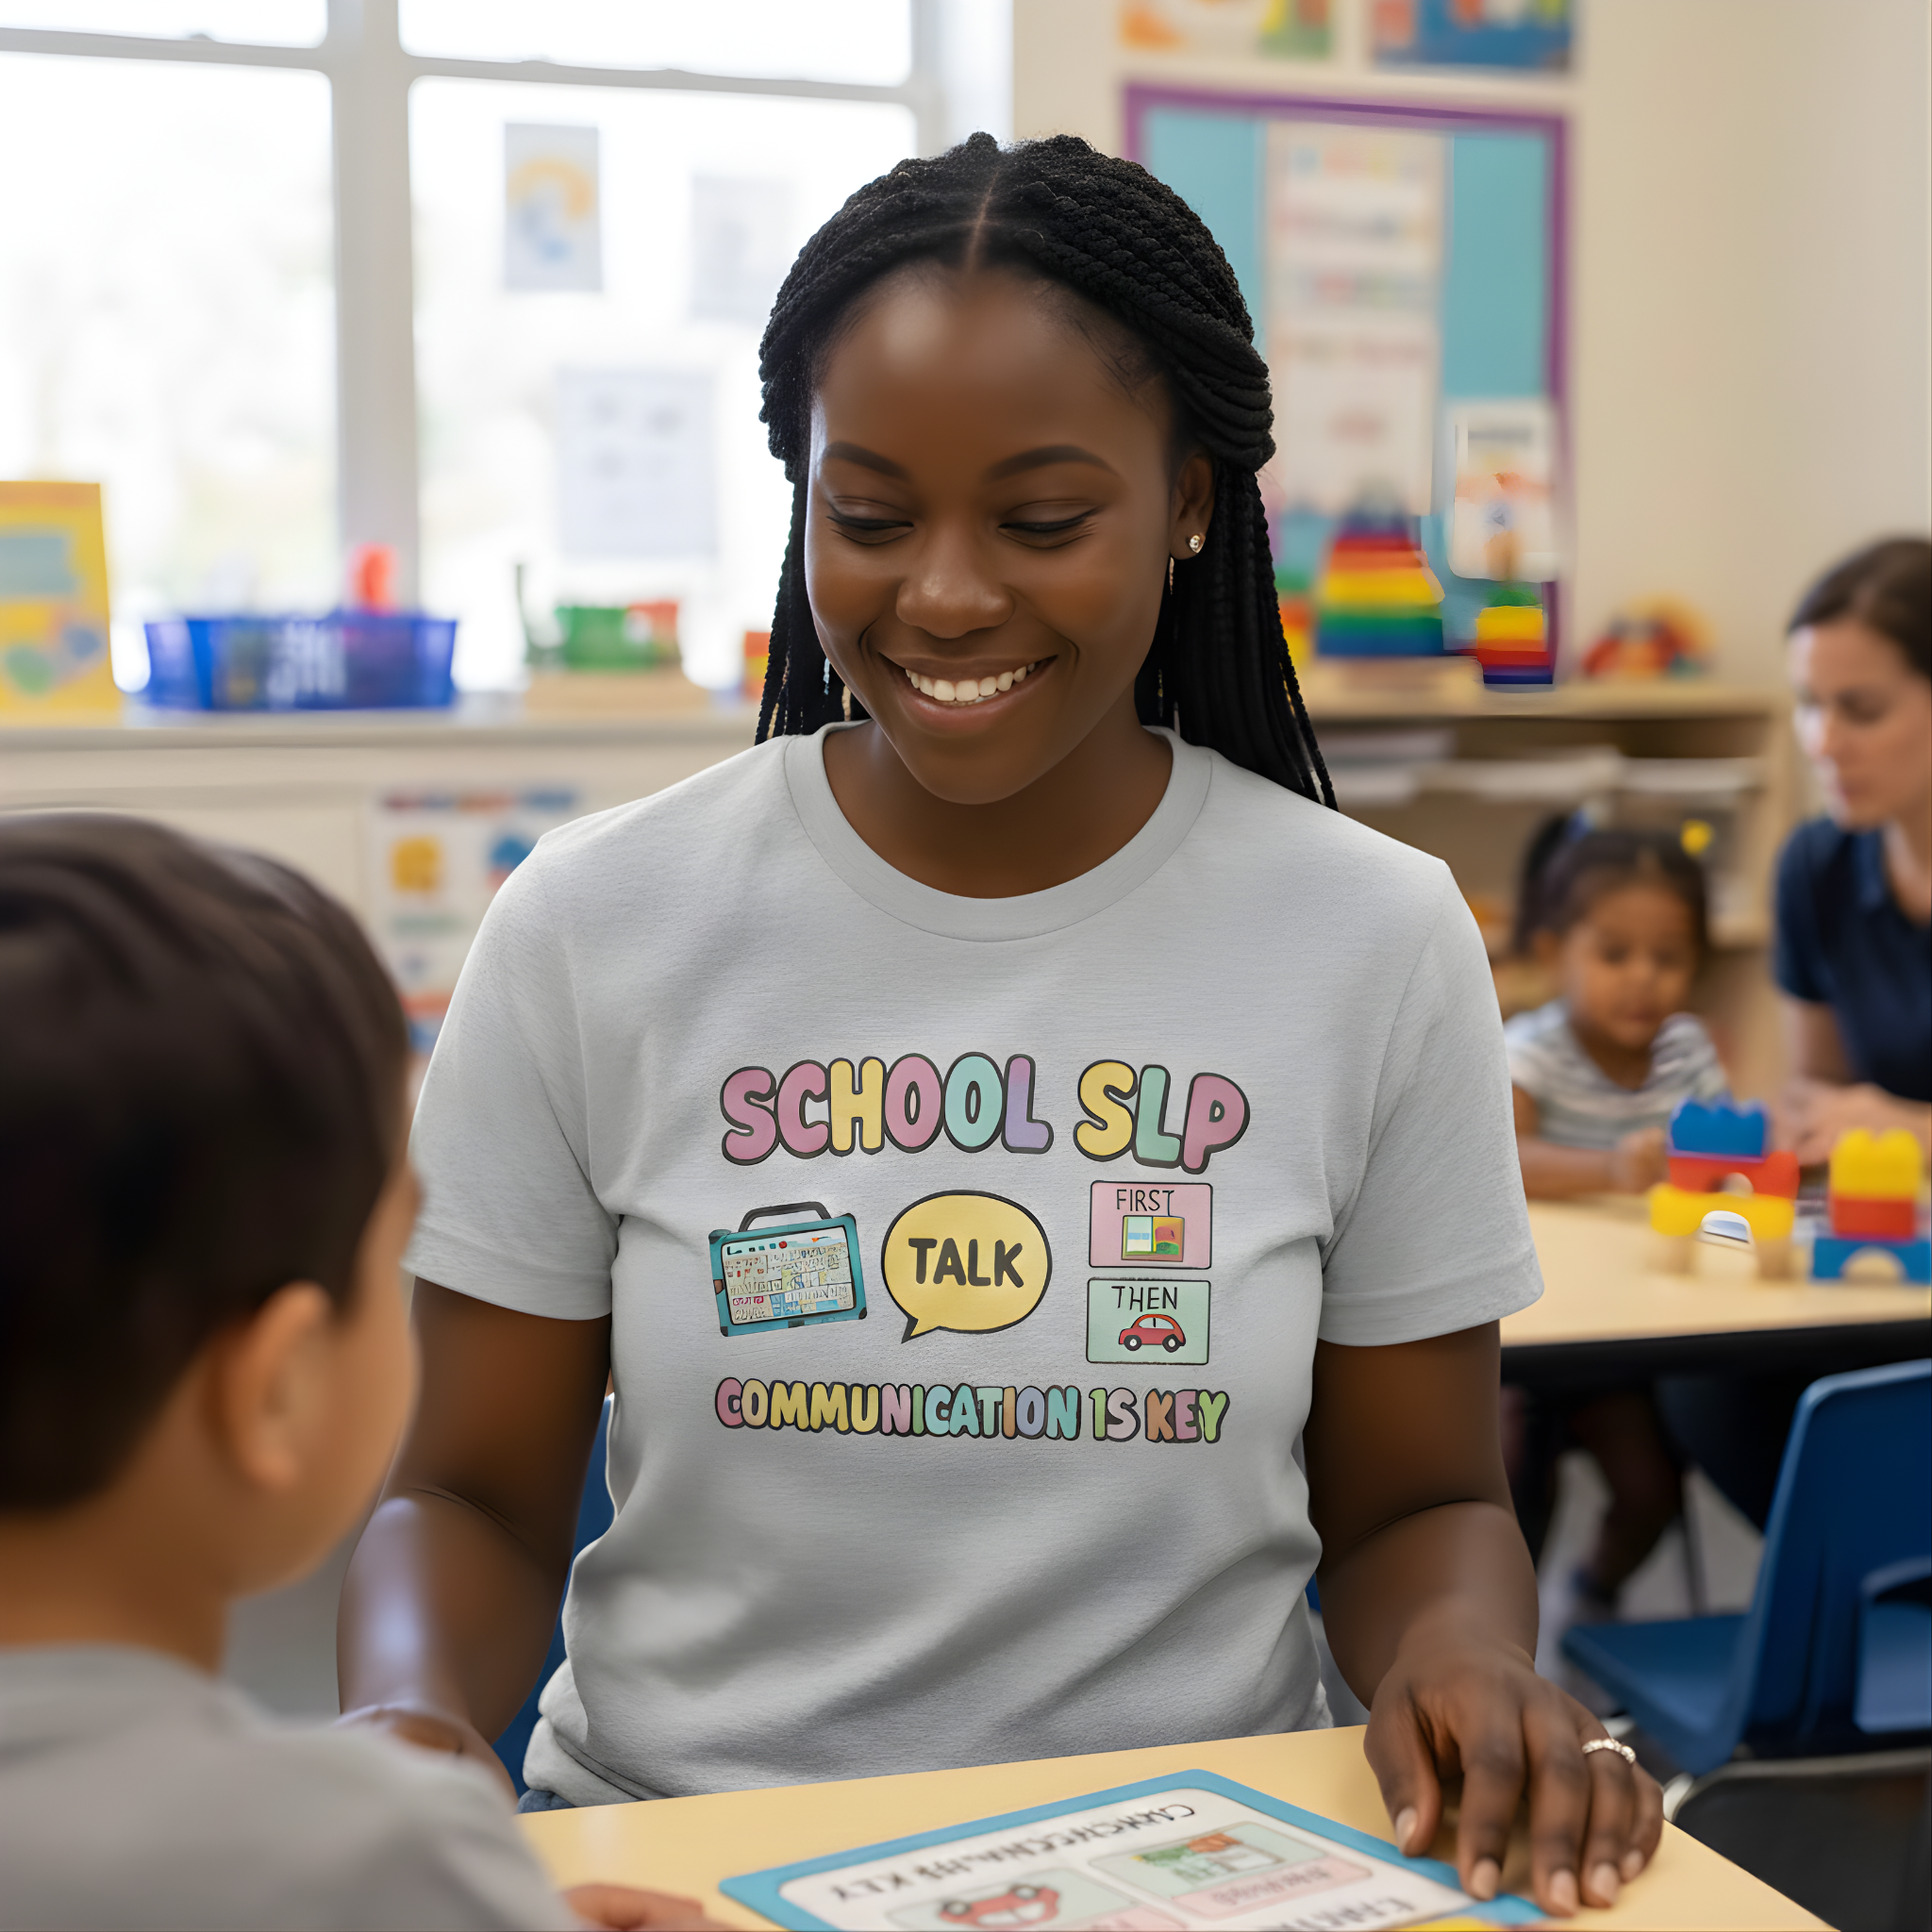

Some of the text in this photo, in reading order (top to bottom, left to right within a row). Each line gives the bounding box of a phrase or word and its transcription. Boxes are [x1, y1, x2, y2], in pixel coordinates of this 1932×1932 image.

[720, 1052, 1251, 1174] SCHOOL SLP
[1116, 1190, 1174, 1216] FIRST
[908, 1238, 1025, 1289] TALK
[1111, 1286, 1178, 1312] THEN
[715, 1376, 1082, 1441] COMMUNICATION
[1144, 1388, 1231, 1444] KEY
